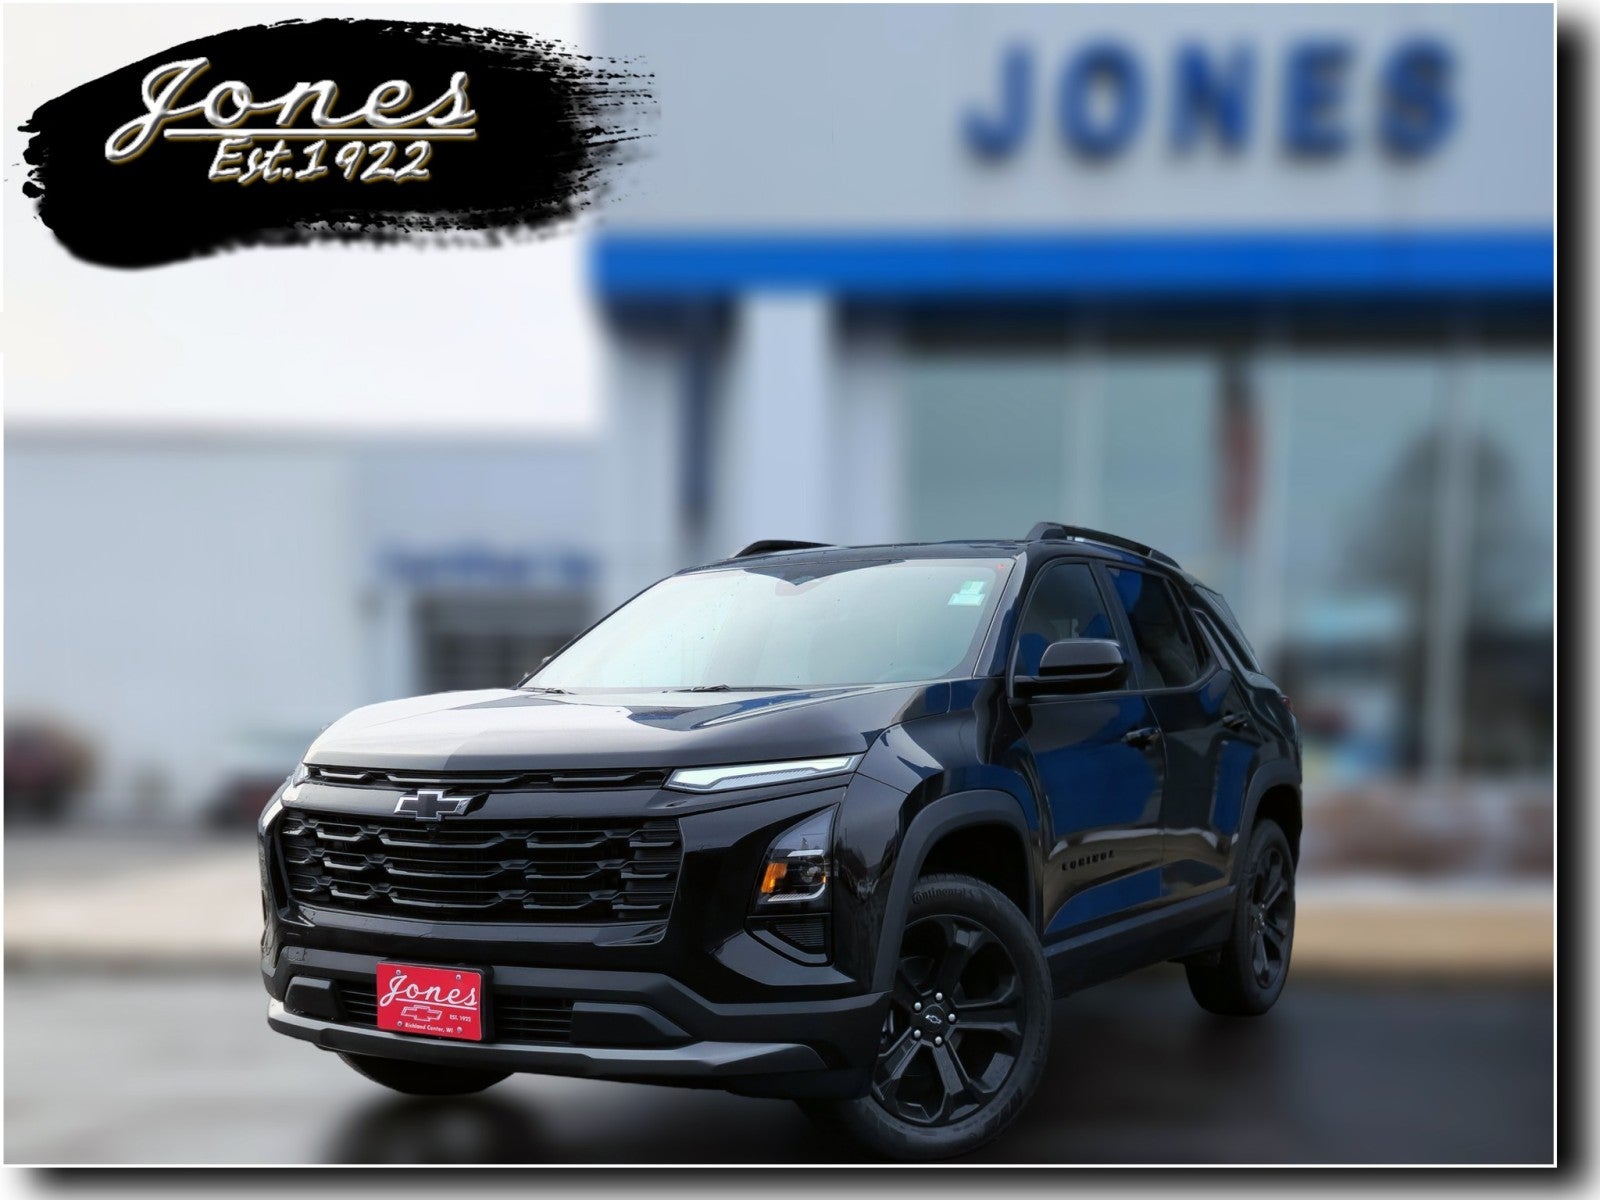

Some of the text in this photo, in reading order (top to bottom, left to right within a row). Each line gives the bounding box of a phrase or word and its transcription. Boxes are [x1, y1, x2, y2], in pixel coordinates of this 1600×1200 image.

[959, 38, 1459, 165] JONES
[380, 974, 477, 1007] Jones
[405, 1022, 426, 1030] Richland
